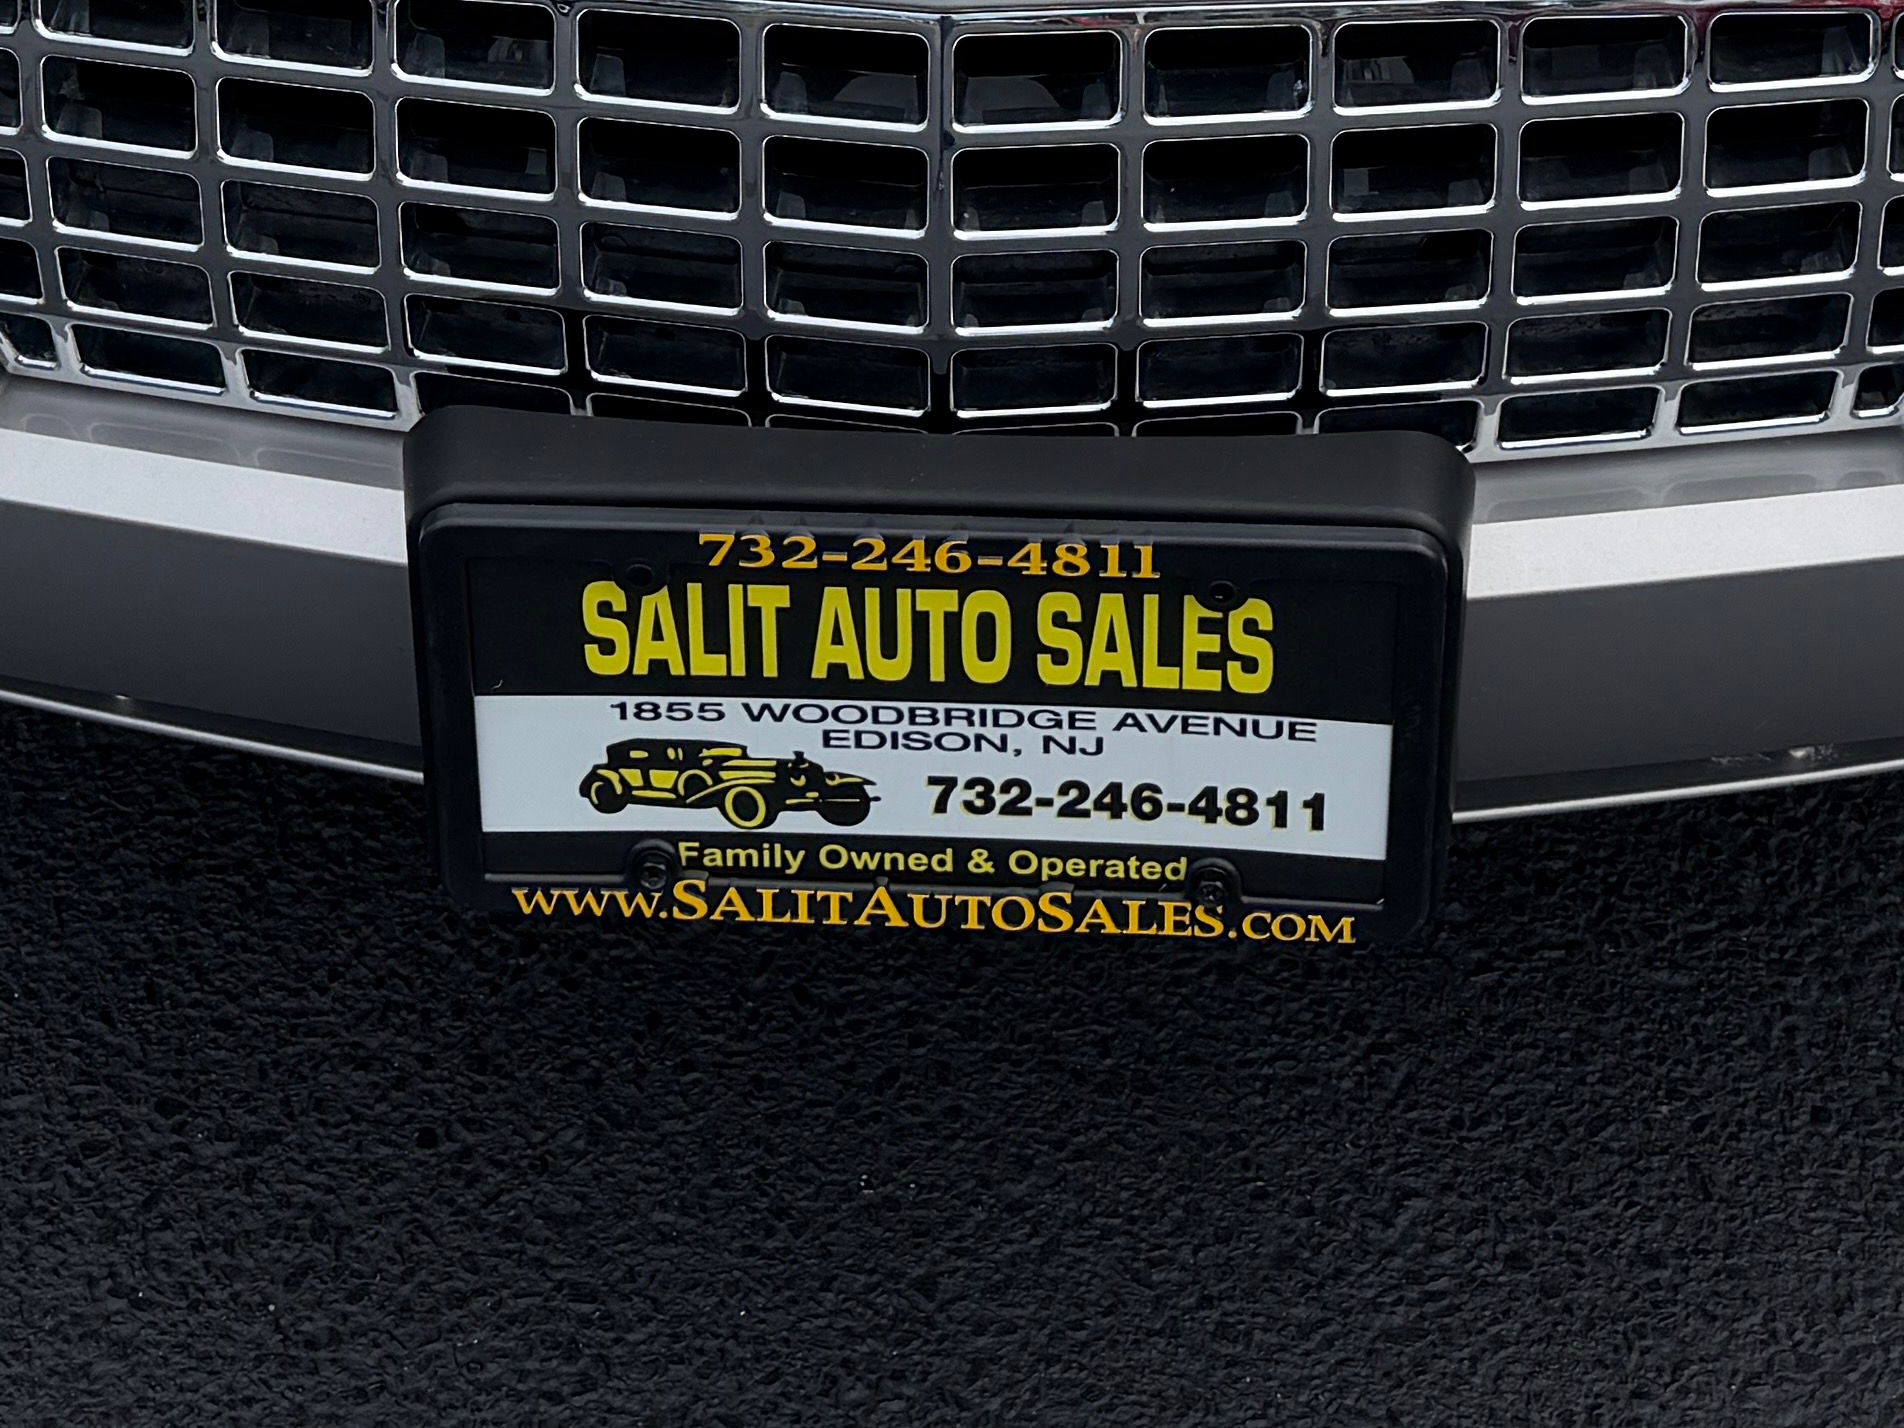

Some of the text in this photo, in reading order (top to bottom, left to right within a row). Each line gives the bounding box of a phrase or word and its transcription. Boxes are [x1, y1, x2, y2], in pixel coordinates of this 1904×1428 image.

[698, 532, 1161, 579] 732-246-4811
[581, 580, 1275, 695] SALIT AUTO SALES
[609, 701, 1318, 743] 1855 WOODBRIDGE AVENUE
[821, 729, 1105, 757] EDISON, NJ
[926, 775, 1326, 832] 732-246-4811
[677, 841, 1188, 882] Family Owned & Operated
